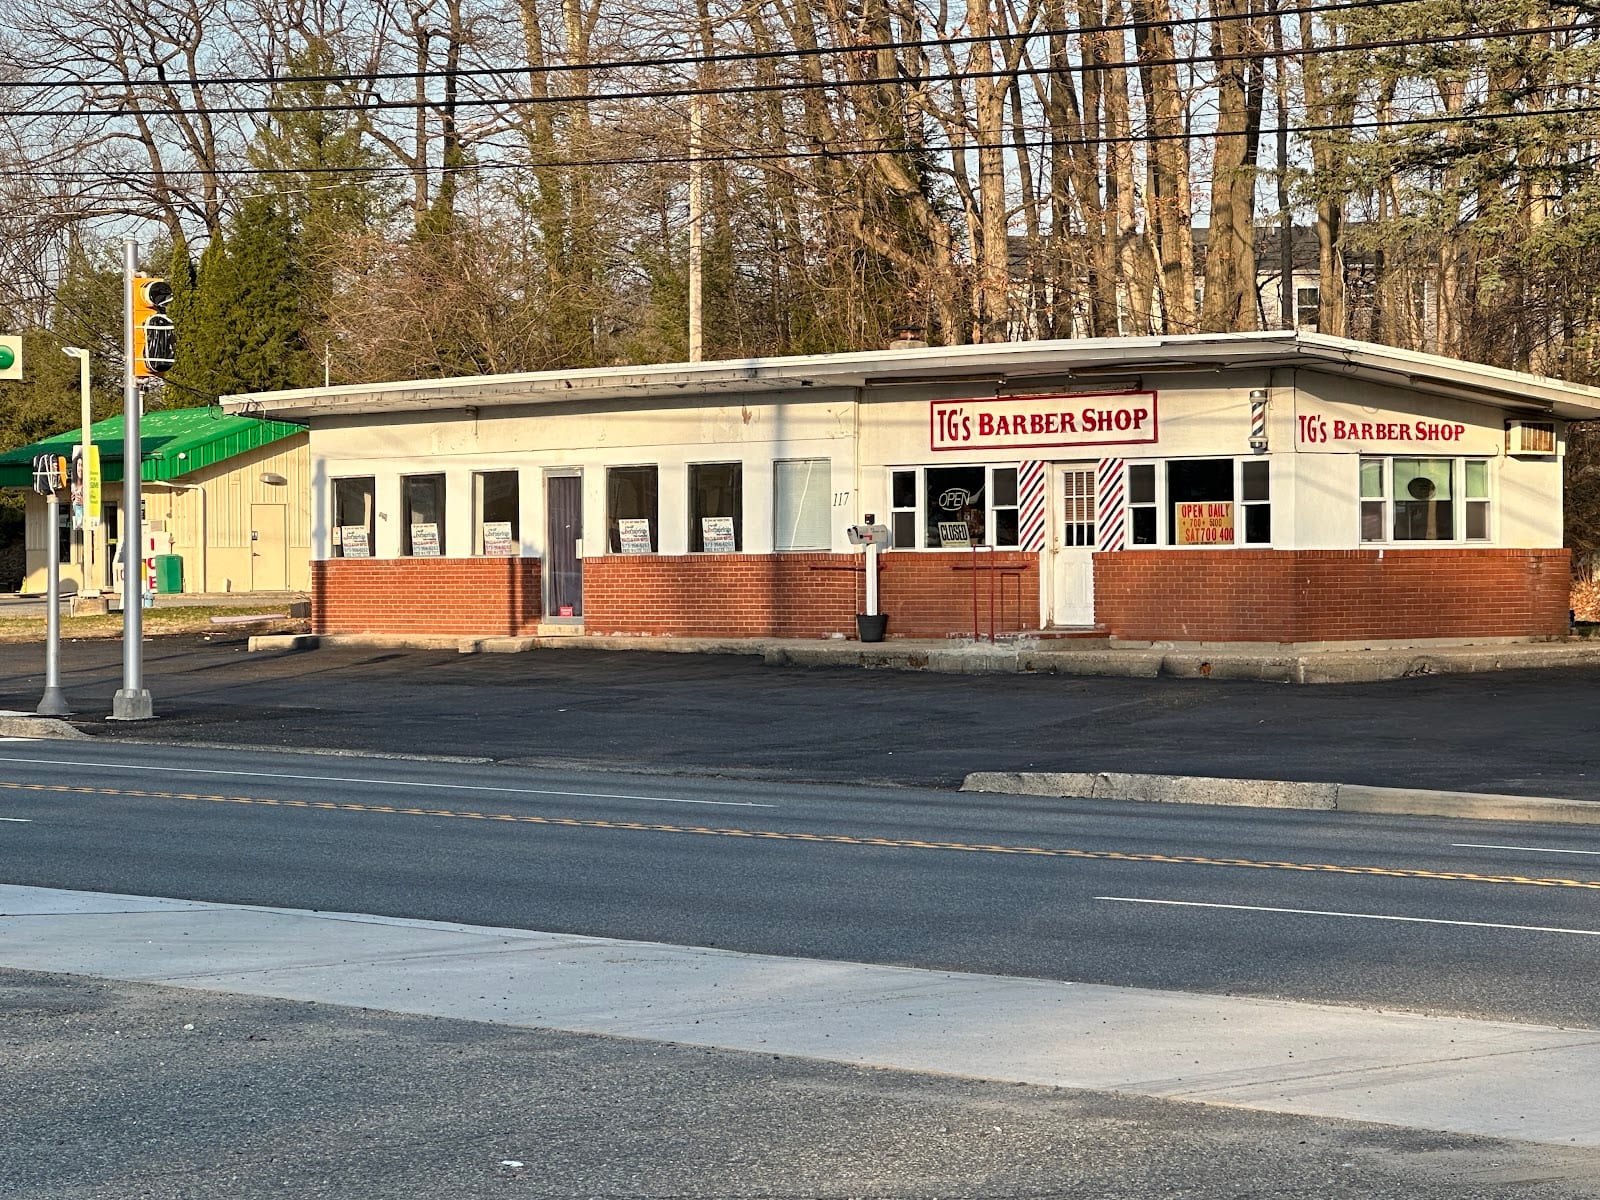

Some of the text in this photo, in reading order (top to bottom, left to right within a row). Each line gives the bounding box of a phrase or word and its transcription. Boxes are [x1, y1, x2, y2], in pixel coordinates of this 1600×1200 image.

[937, 408, 1149, 442] TG's BARBER SHOP
[1299, 414, 1466, 443] TG's BARBER SHOP
[833, 491, 850, 507] 117
[939, 491, 971, 507] OPEN
[1181, 503, 1231, 518] OPEN DAILY
[940, 524, 968, 541] CLOSED
[1185, 528, 1200, 542] SAT
[1219, 527, 1234, 541] 400
